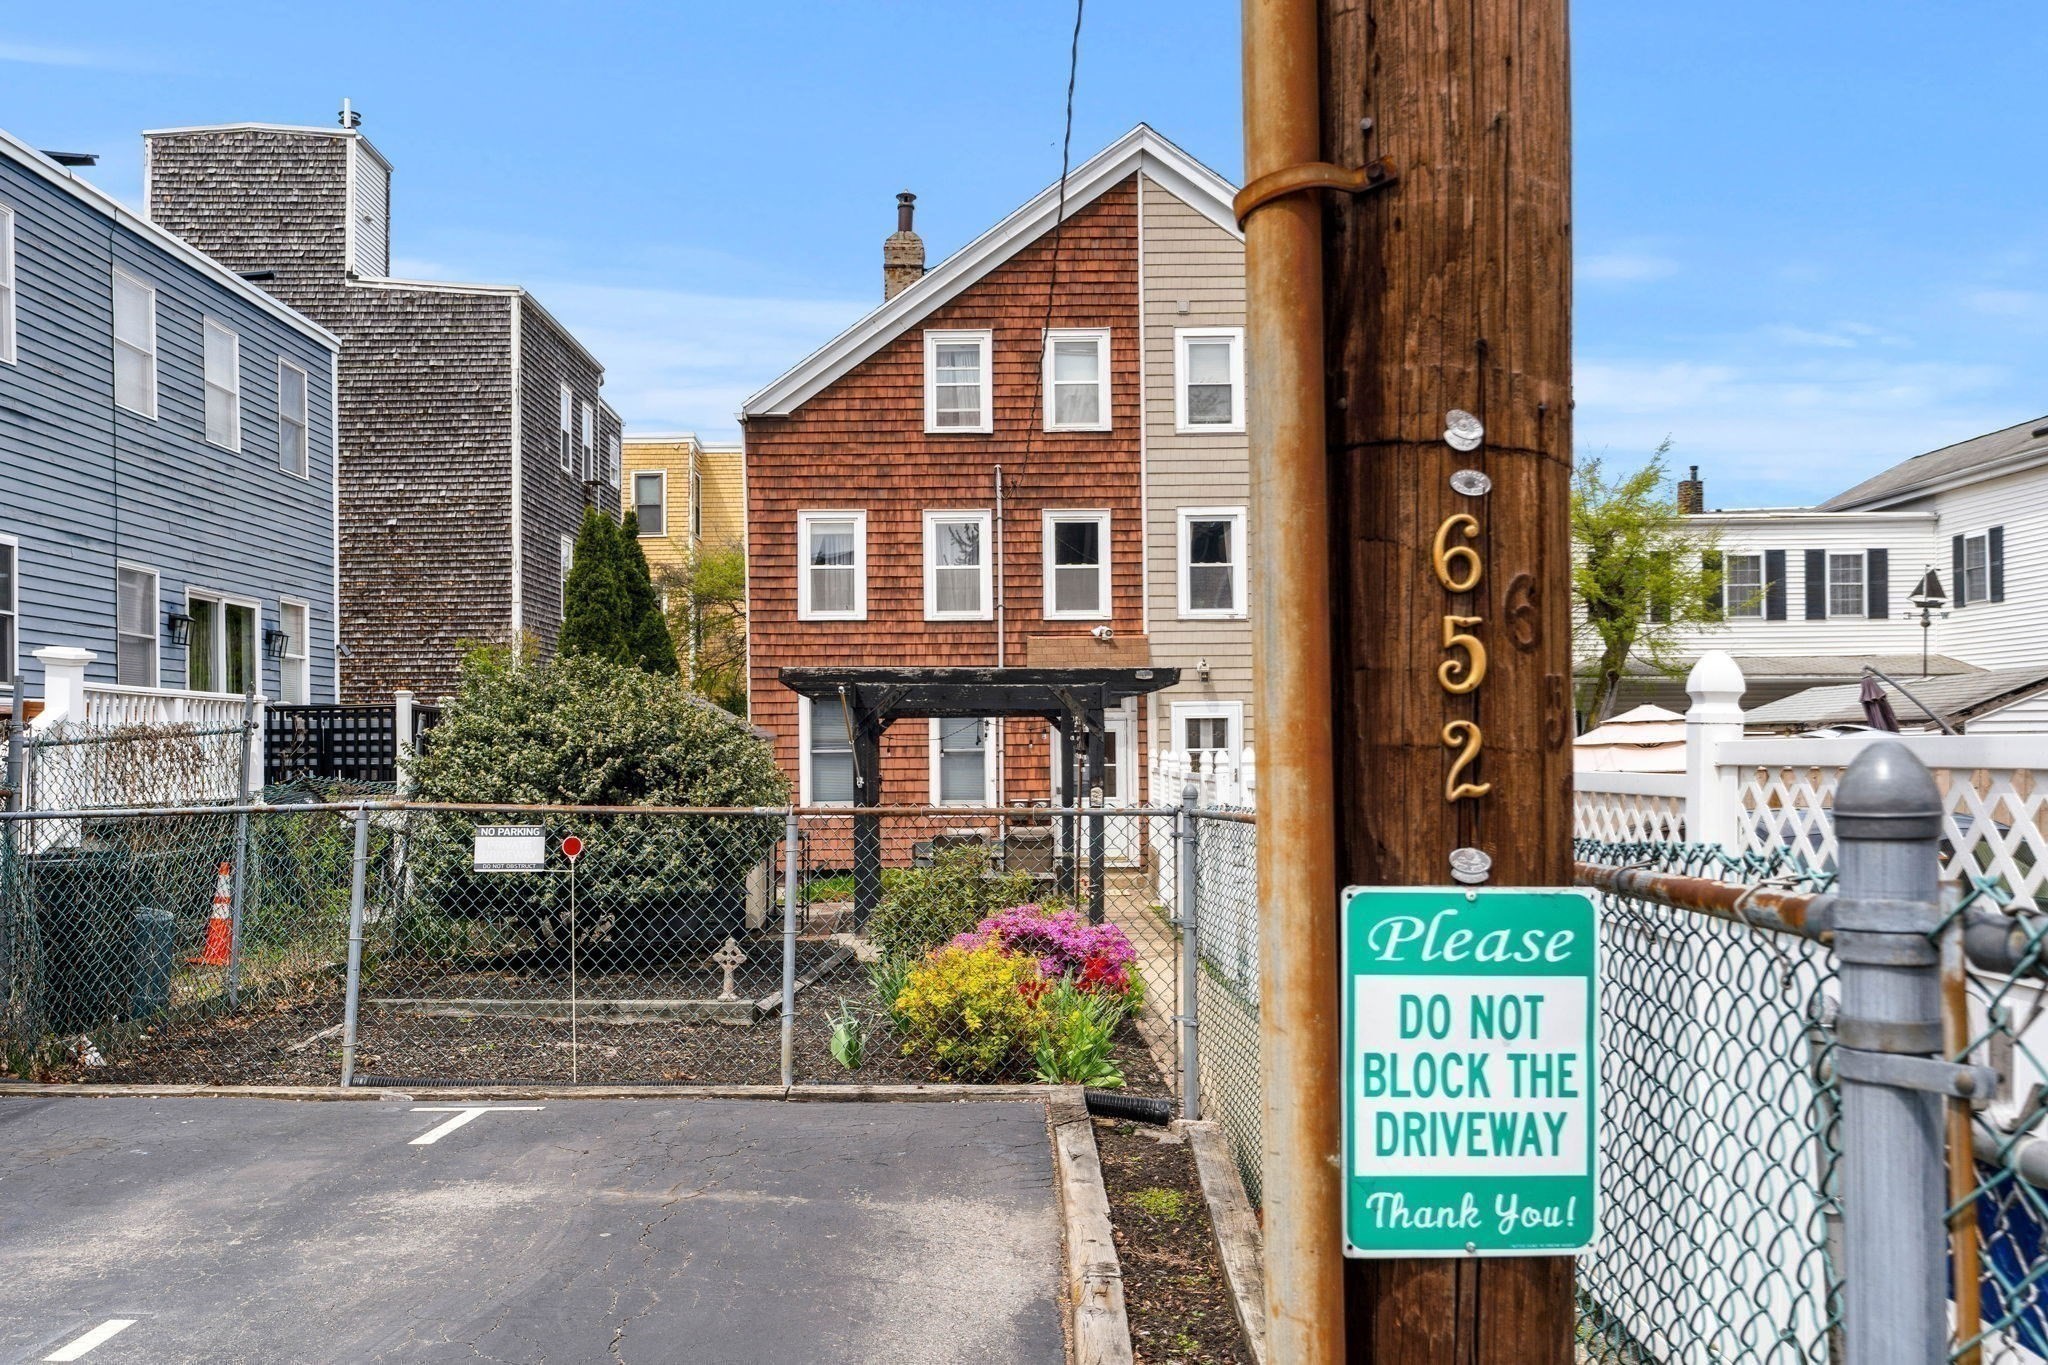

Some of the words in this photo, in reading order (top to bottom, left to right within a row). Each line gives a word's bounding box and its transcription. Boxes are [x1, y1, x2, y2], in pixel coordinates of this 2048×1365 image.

[1432, 513, 1491, 802] 652
[481, 828, 495, 836] NO
[498, 828, 540, 836] PARKING
[1367, 908, 1576, 963] Please
[1399, 993, 1451, 1040] DO
[1470, 993, 1545, 1041] NOT
[1363, 1052, 1491, 1099] BLOCK
[1507, 1052, 1579, 1099] THE
[1375, 1111, 1568, 1157] DRIVEWAY
[1366, 1191, 1482, 1229] Thank
[1494, 1192, 1577, 1235] You!
